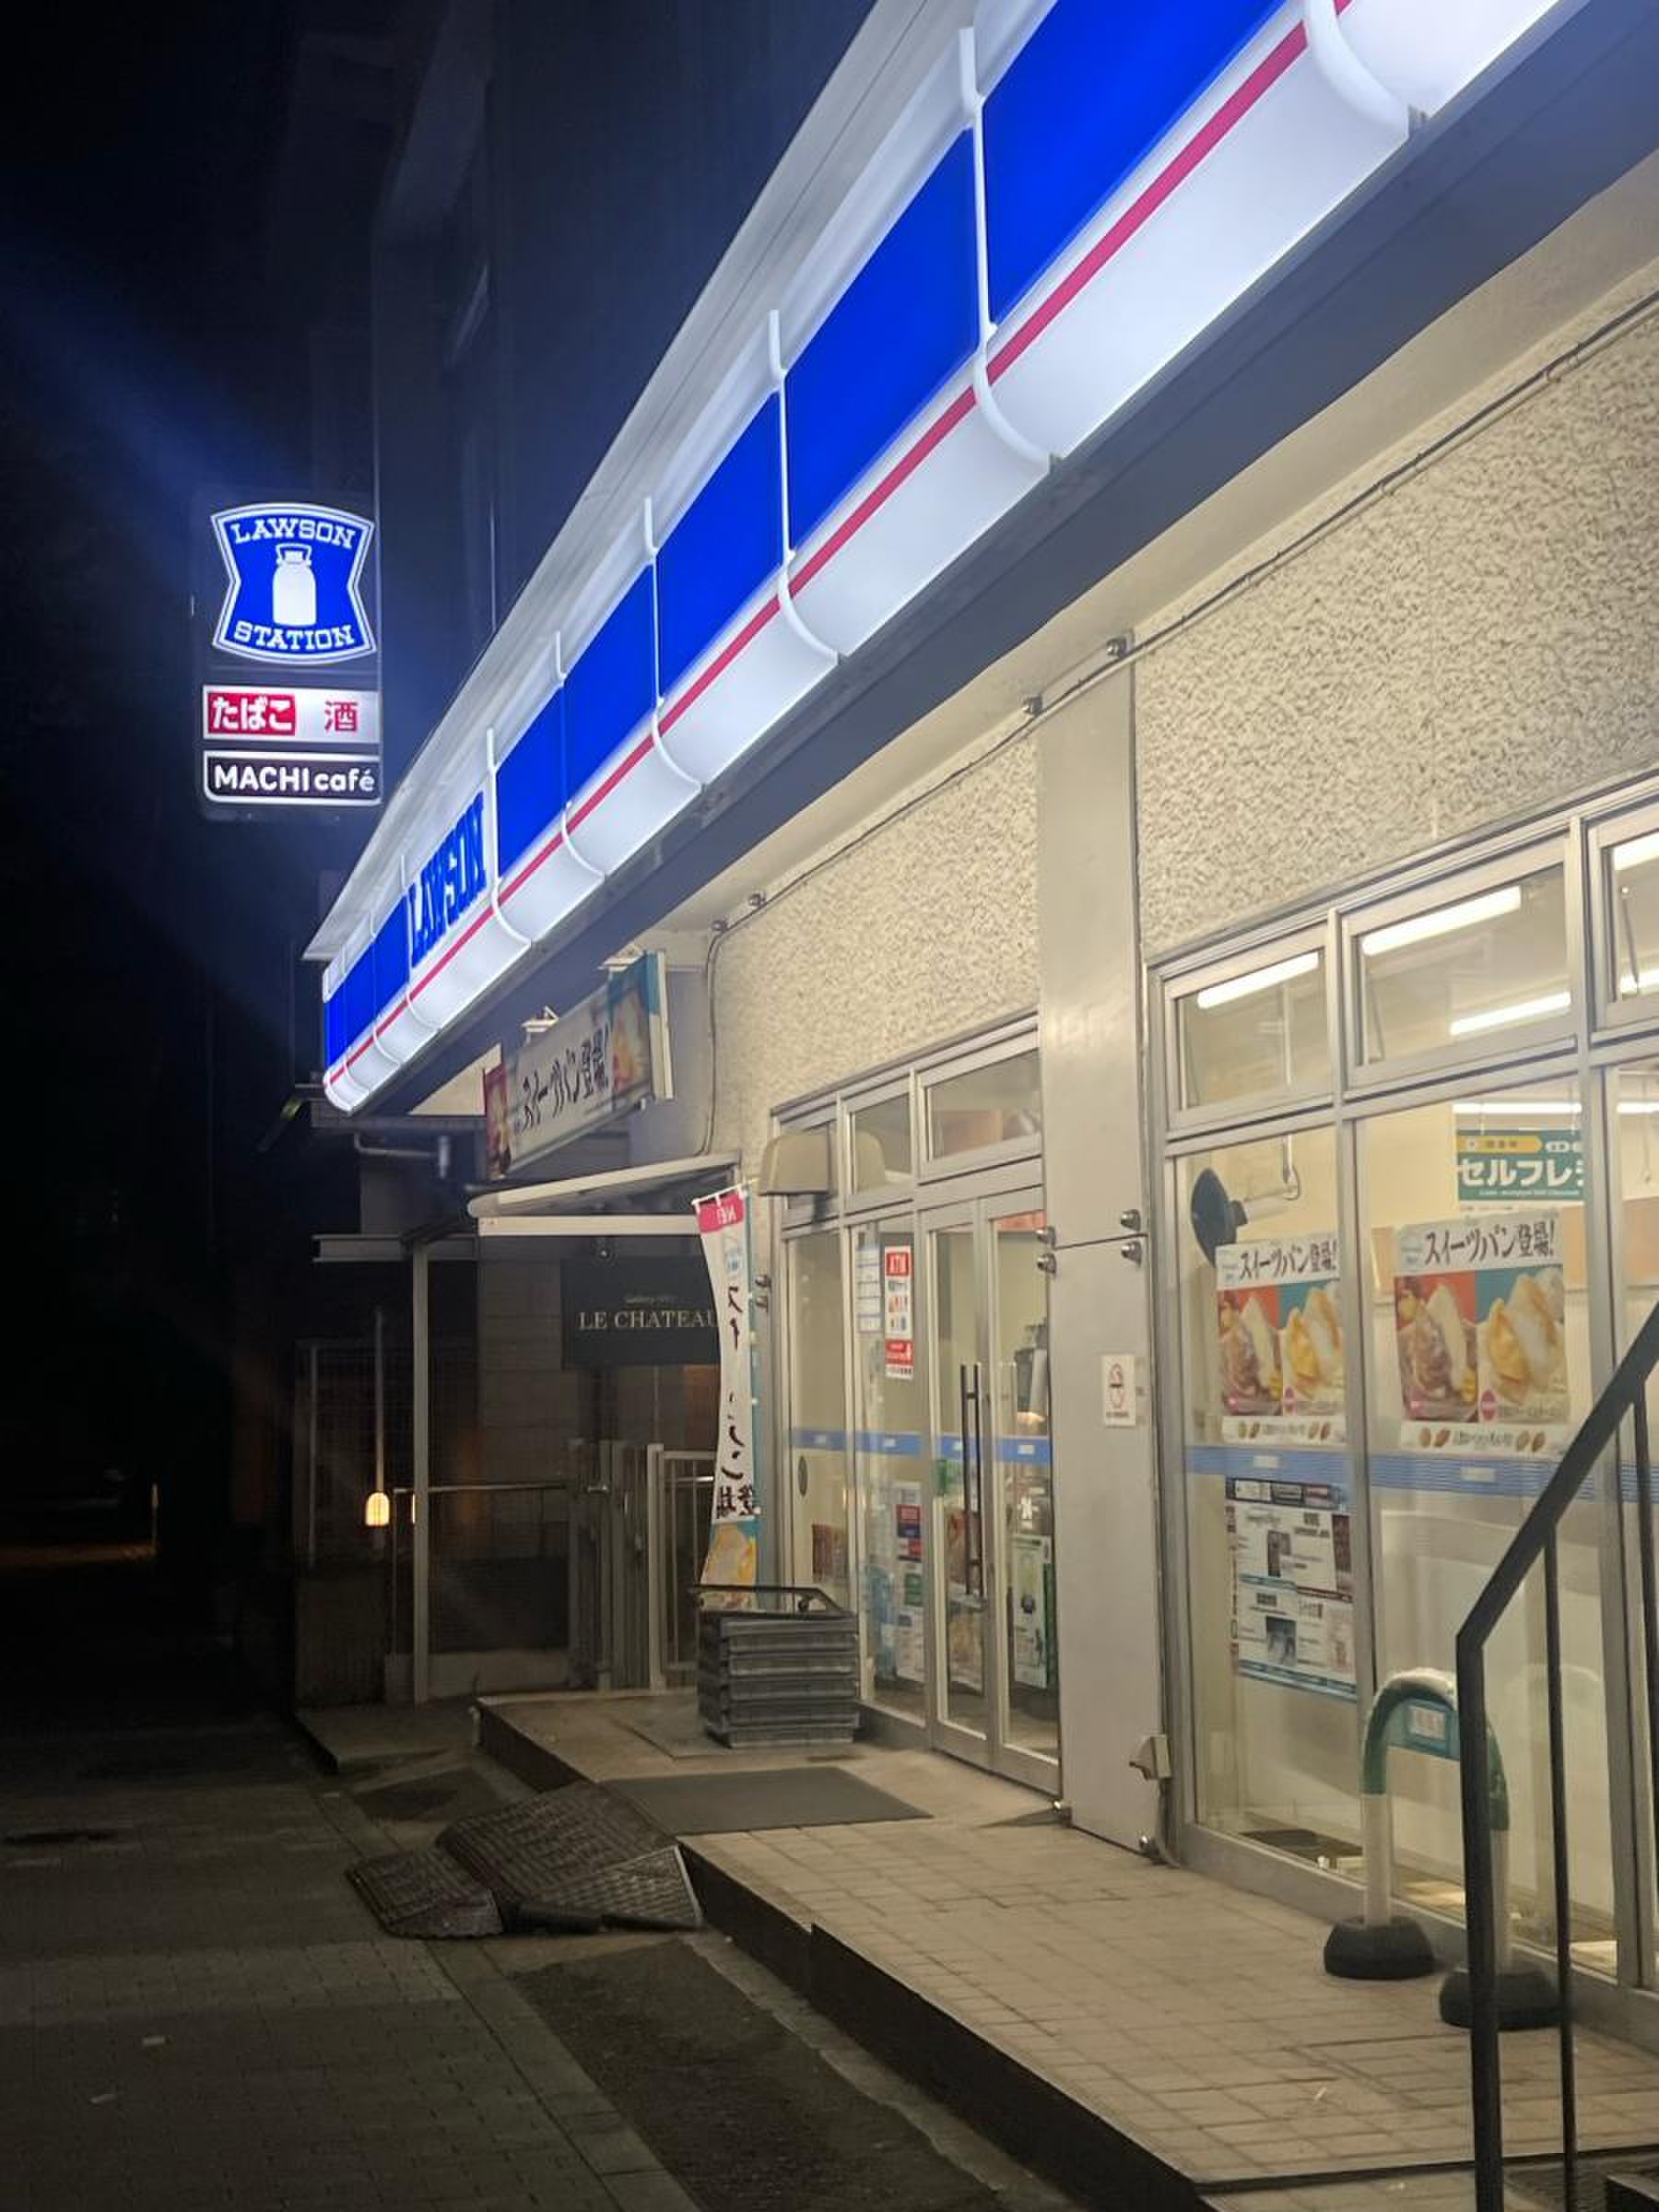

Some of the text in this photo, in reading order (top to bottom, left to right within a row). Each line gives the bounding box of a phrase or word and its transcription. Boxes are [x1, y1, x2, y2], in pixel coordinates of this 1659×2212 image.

[231, 518, 356, 550] LAWSON
[233, 620, 356, 651] STATION
[213, 696, 293, 730] たばこ
[324, 700, 359, 733] 酒
[214, 765, 375, 793] MACHI café
[411, 791, 486, 968] LAWSON
[579, 1312, 606, 1328] LE
